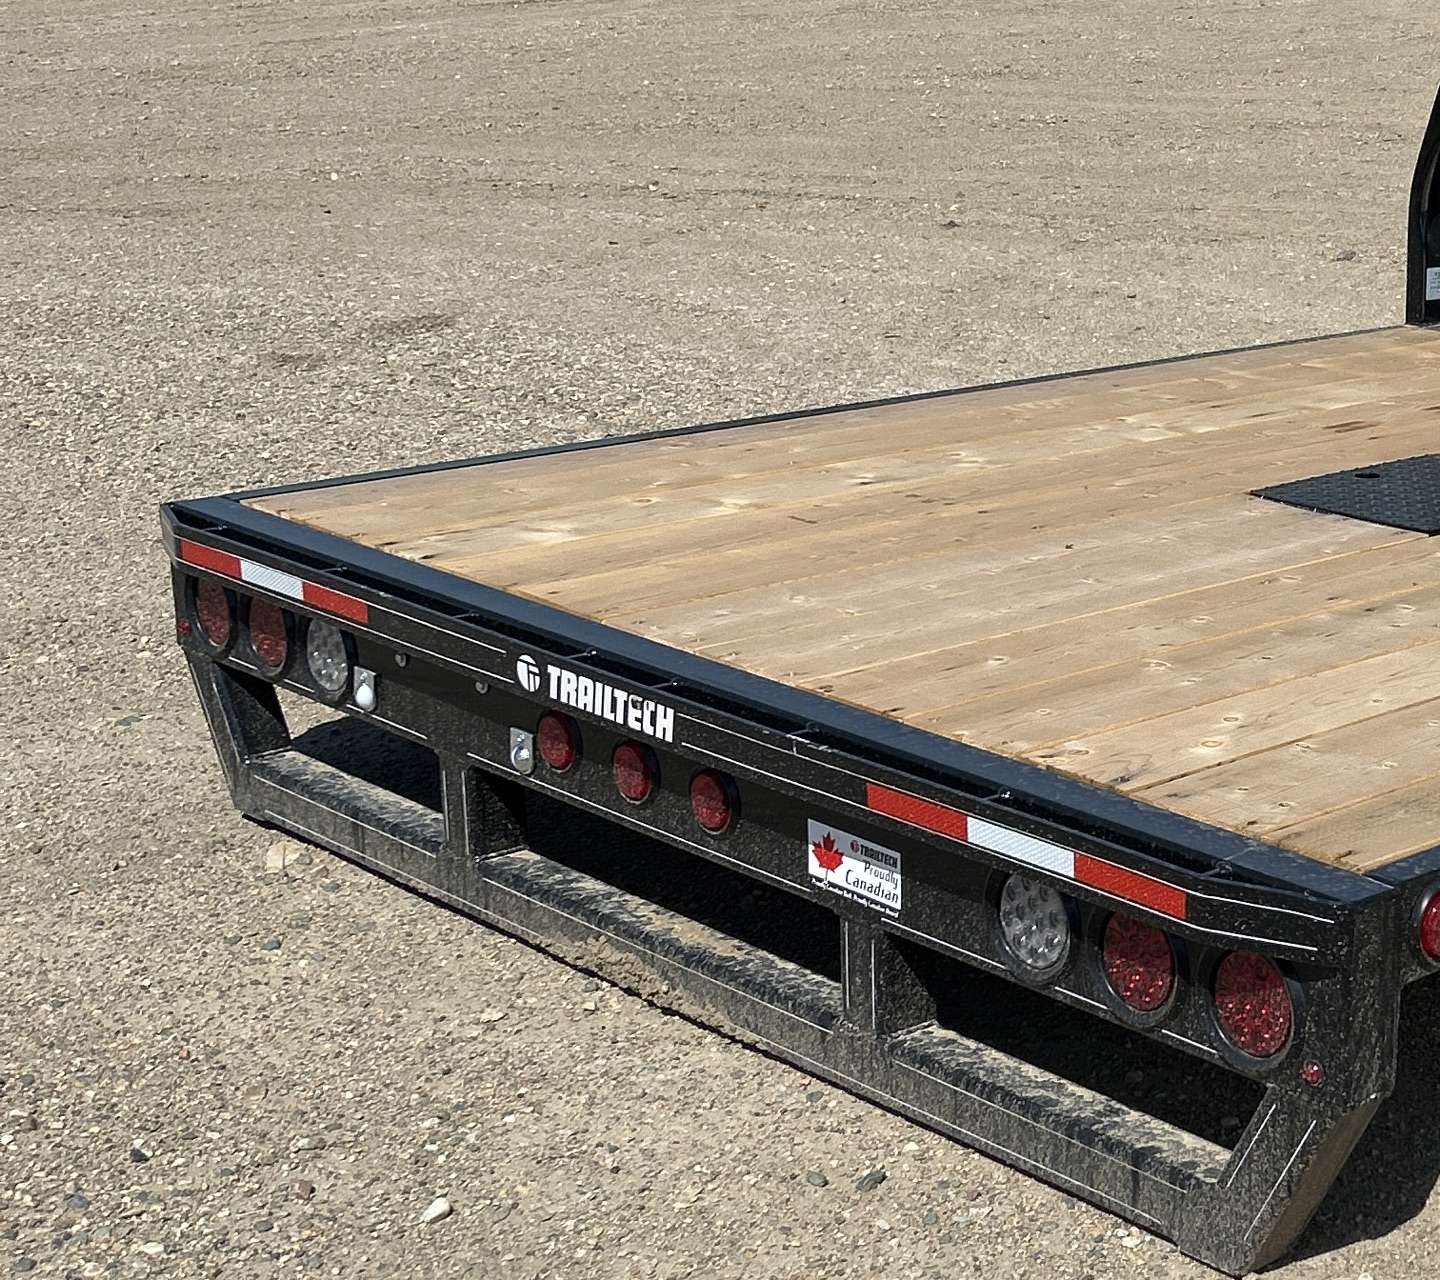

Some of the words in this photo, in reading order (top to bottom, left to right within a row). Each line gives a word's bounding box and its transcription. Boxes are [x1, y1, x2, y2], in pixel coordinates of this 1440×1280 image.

[547, 664, 675, 743] TRAILTECH
[860, 844, 898, 869] TRAILTECH
[845, 869, 899, 904] Canadian
[862, 860, 899, 890] Proudly
